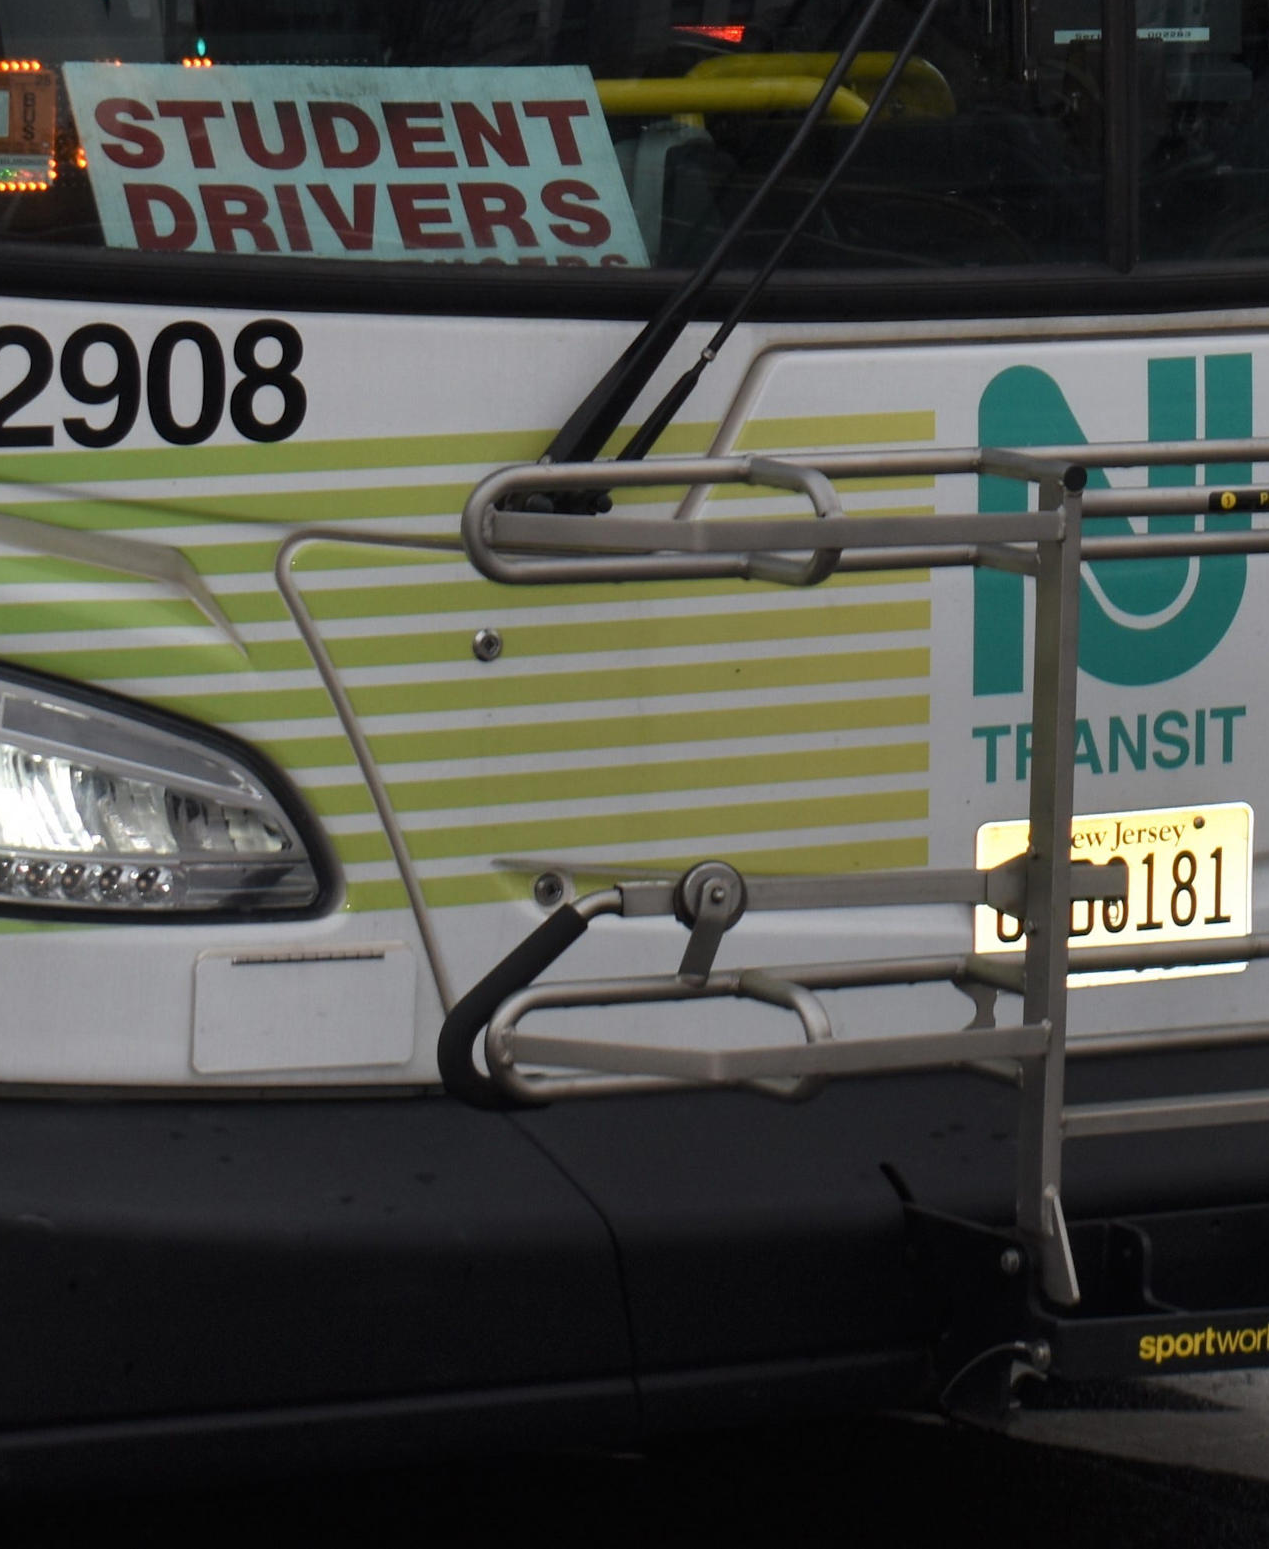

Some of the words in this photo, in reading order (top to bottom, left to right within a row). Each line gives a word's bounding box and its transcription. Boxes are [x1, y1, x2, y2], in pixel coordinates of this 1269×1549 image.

[23, 92, 36, 141] BUS
[94, 97, 590, 170] STUDENT
[122, 179, 612, 252] DRIVERS
[1110, 821, 1186, 852] Jersey
